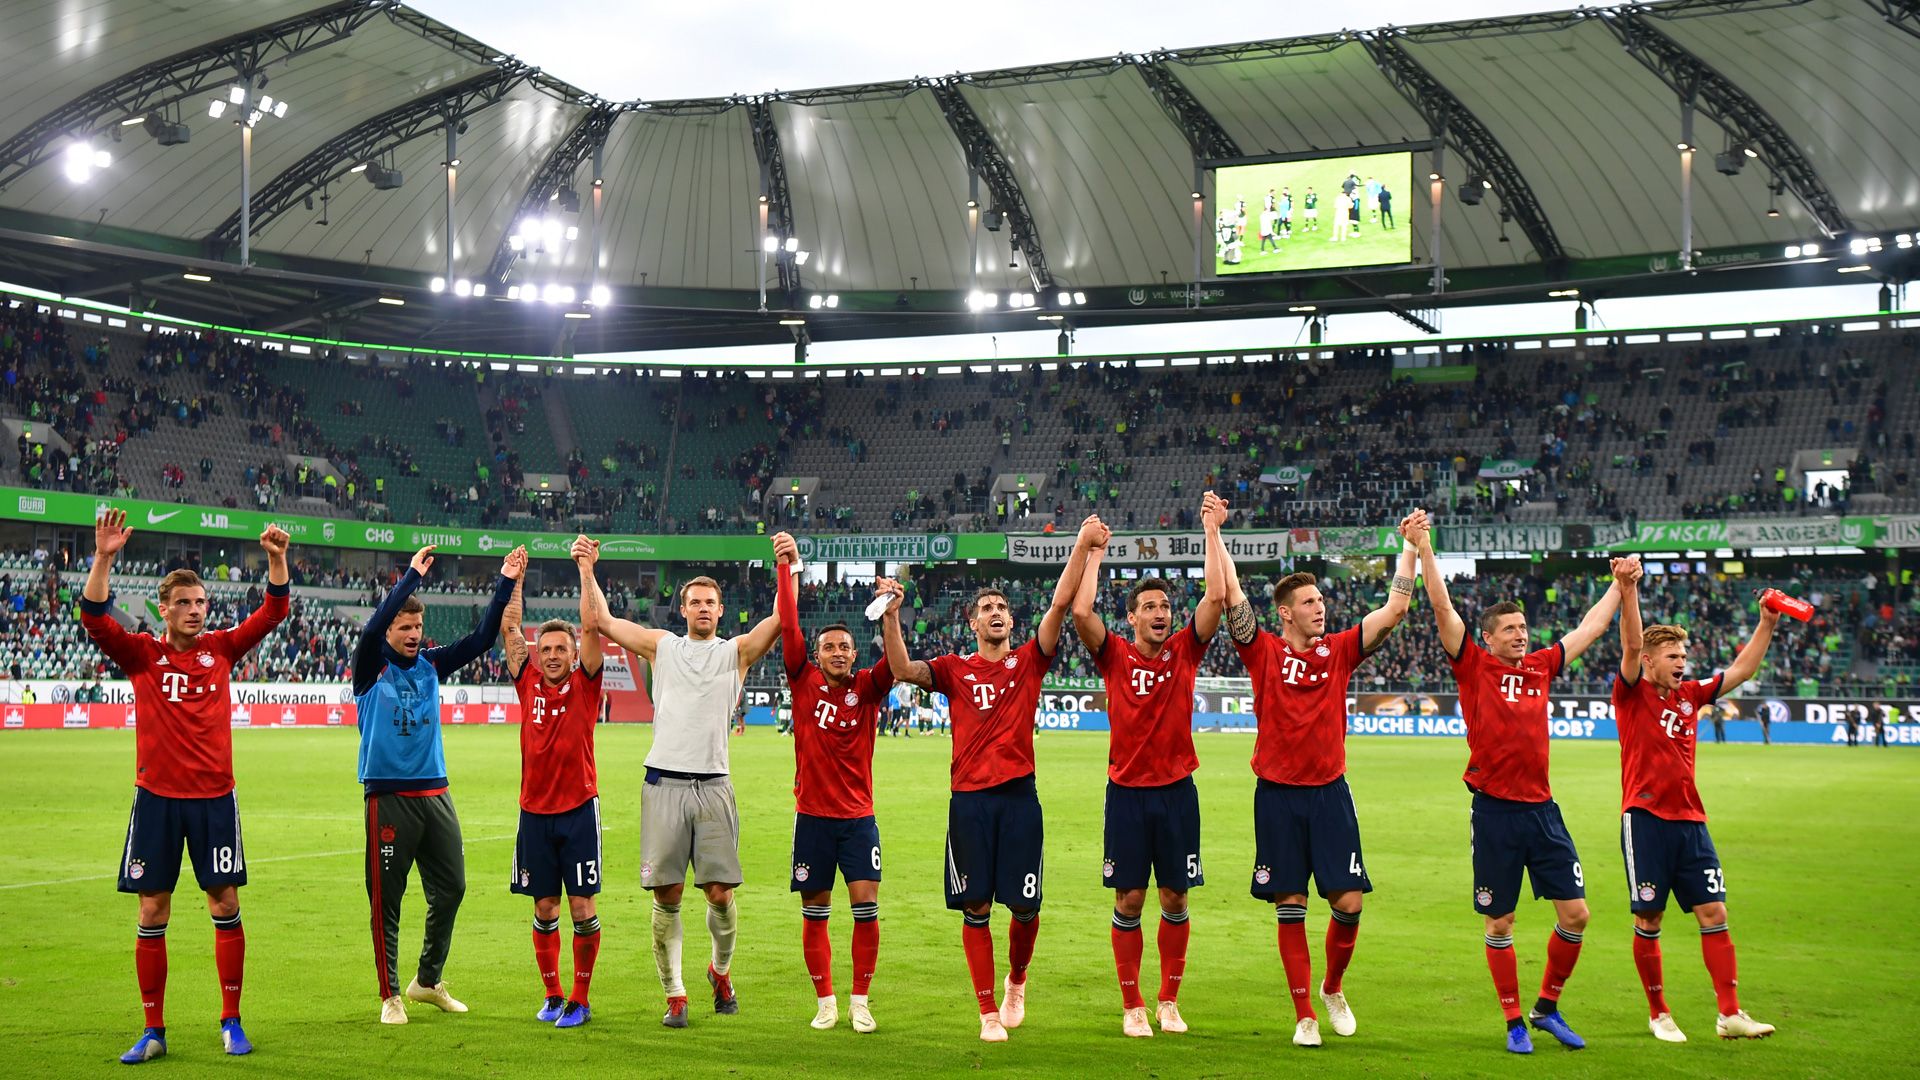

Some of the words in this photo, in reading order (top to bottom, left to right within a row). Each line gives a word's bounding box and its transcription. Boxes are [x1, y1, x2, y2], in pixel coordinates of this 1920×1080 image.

[1170, 289, 1224, 300] WOLFBURG
[263, 521, 308, 533] HRMANN
[365, 528, 395, 543] CHG
[1443, 525, 1563, 551] WEEKEND
[421, 533, 462, 547] VELTINS
[819, 542, 926, 558] ZINNENWAPPEN
[1168, 537, 1279, 558] Wolburg
[237, 689, 326, 704] Volkswagen
[1038, 713, 1080, 728] JOB?
[1354, 717, 1414, 734] SUCHE
[213, 846, 232, 873] 18
[871, 846, 881, 871] 6
[1186, 854, 1197, 878] 5
[1349, 852, 1361, 876] 4
[576, 860, 597, 886] 13
[1572, 862, 1584, 887] 9
[1703, 867, 1726, 893] 32
[1022, 873, 1036, 898] 8
